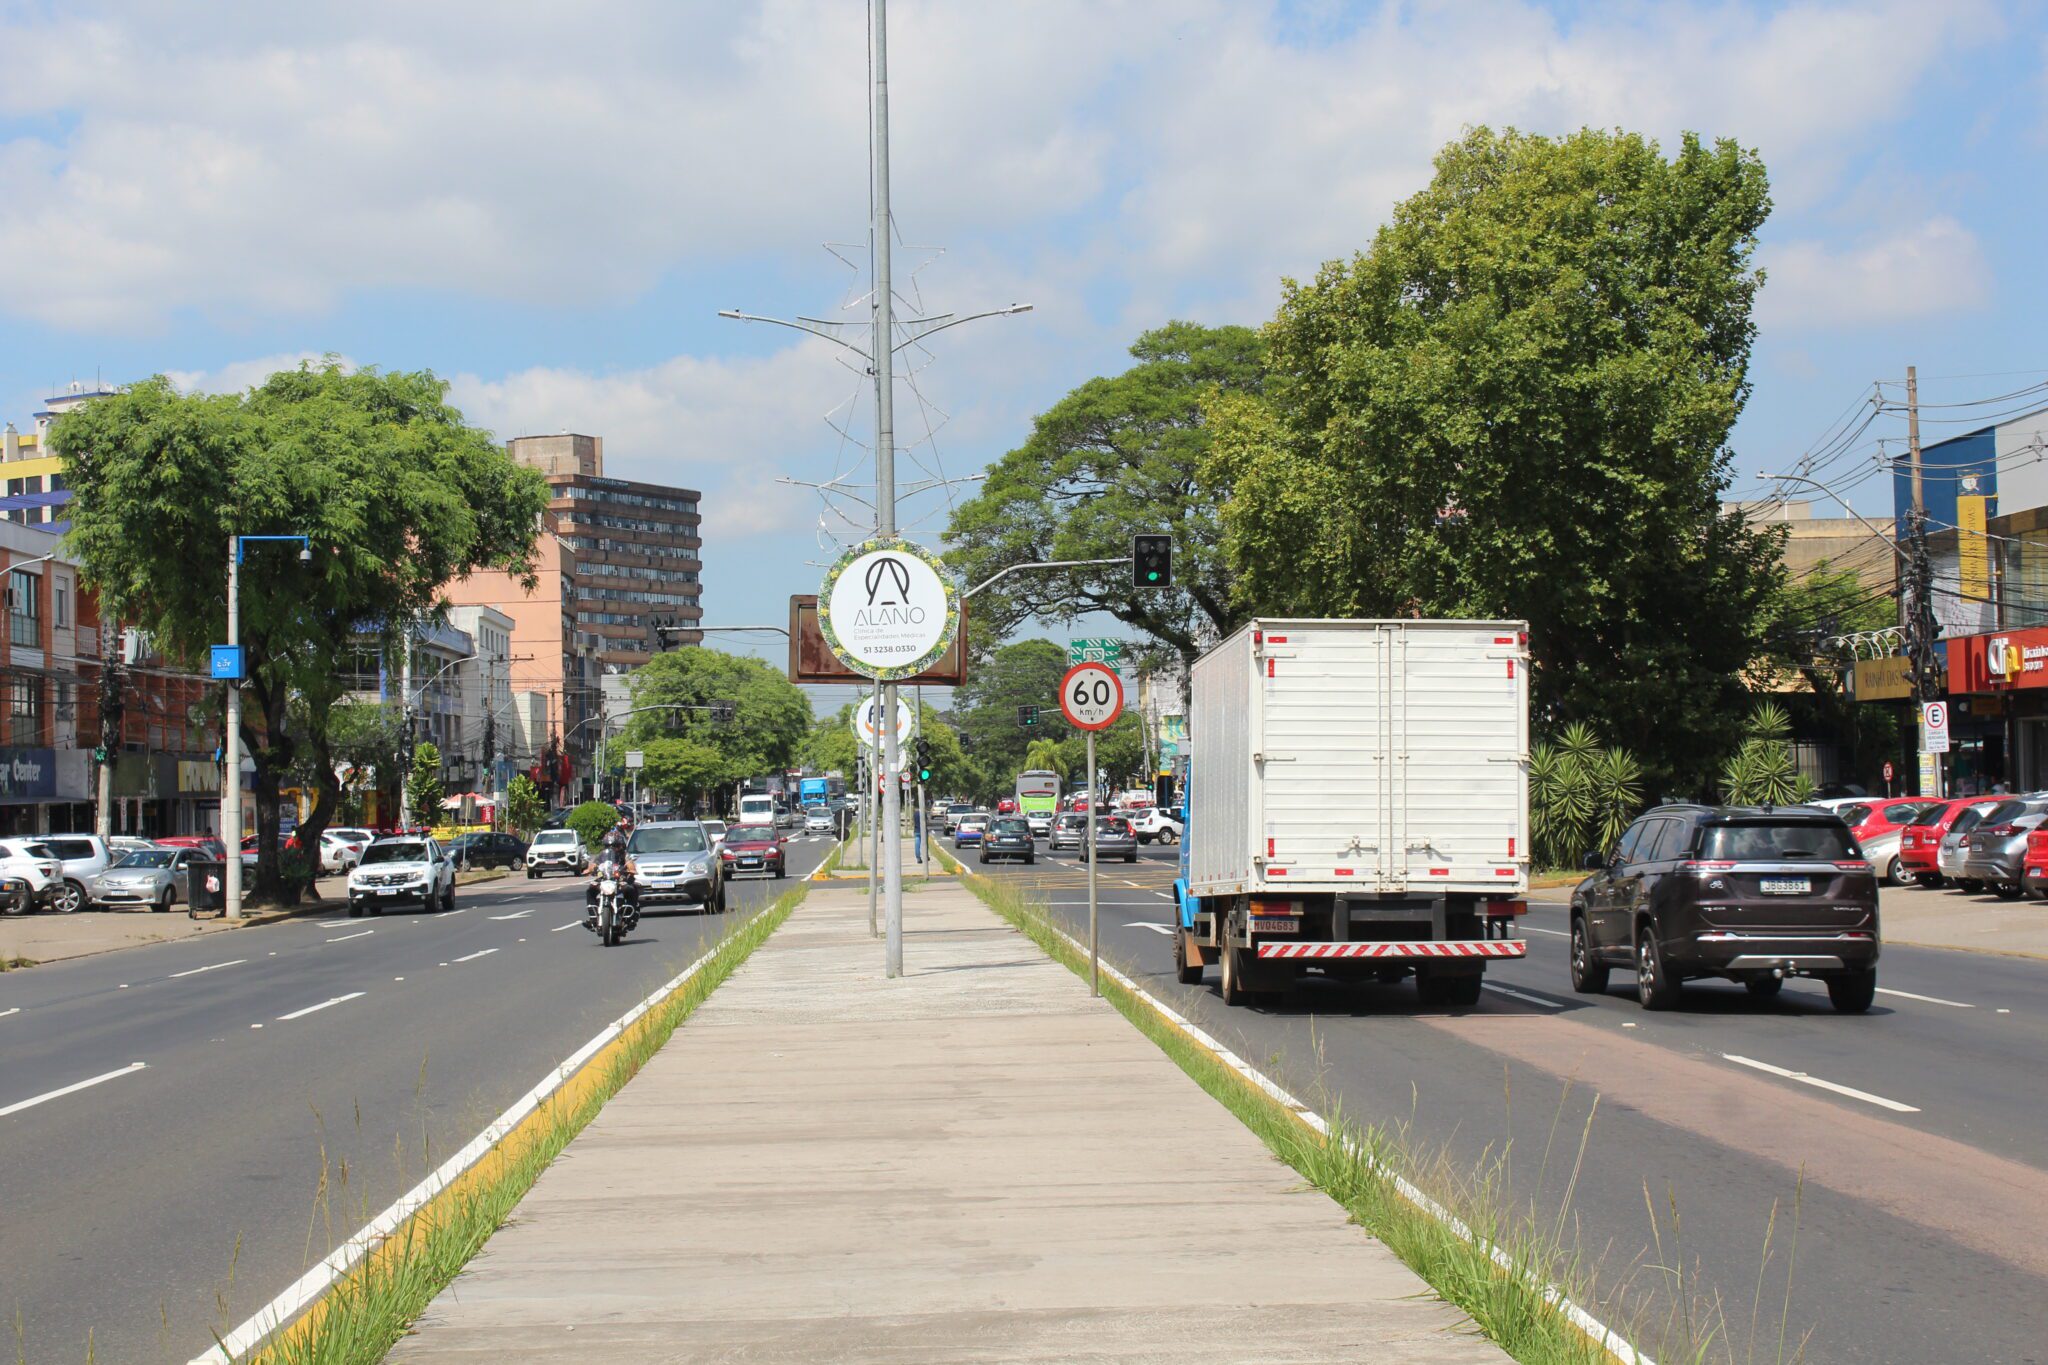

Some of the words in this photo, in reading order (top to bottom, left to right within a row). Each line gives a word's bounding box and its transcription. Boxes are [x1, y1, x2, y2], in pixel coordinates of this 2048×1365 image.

[854, 607, 925, 626] ALANO
[874, 645, 916, 653] 3238.0330
[1073, 680, 1110, 705] 60
[1079, 708, 1104, 716] km/h
[1931, 709, 1940, 722] E
[13, 758, 41, 781] Center
